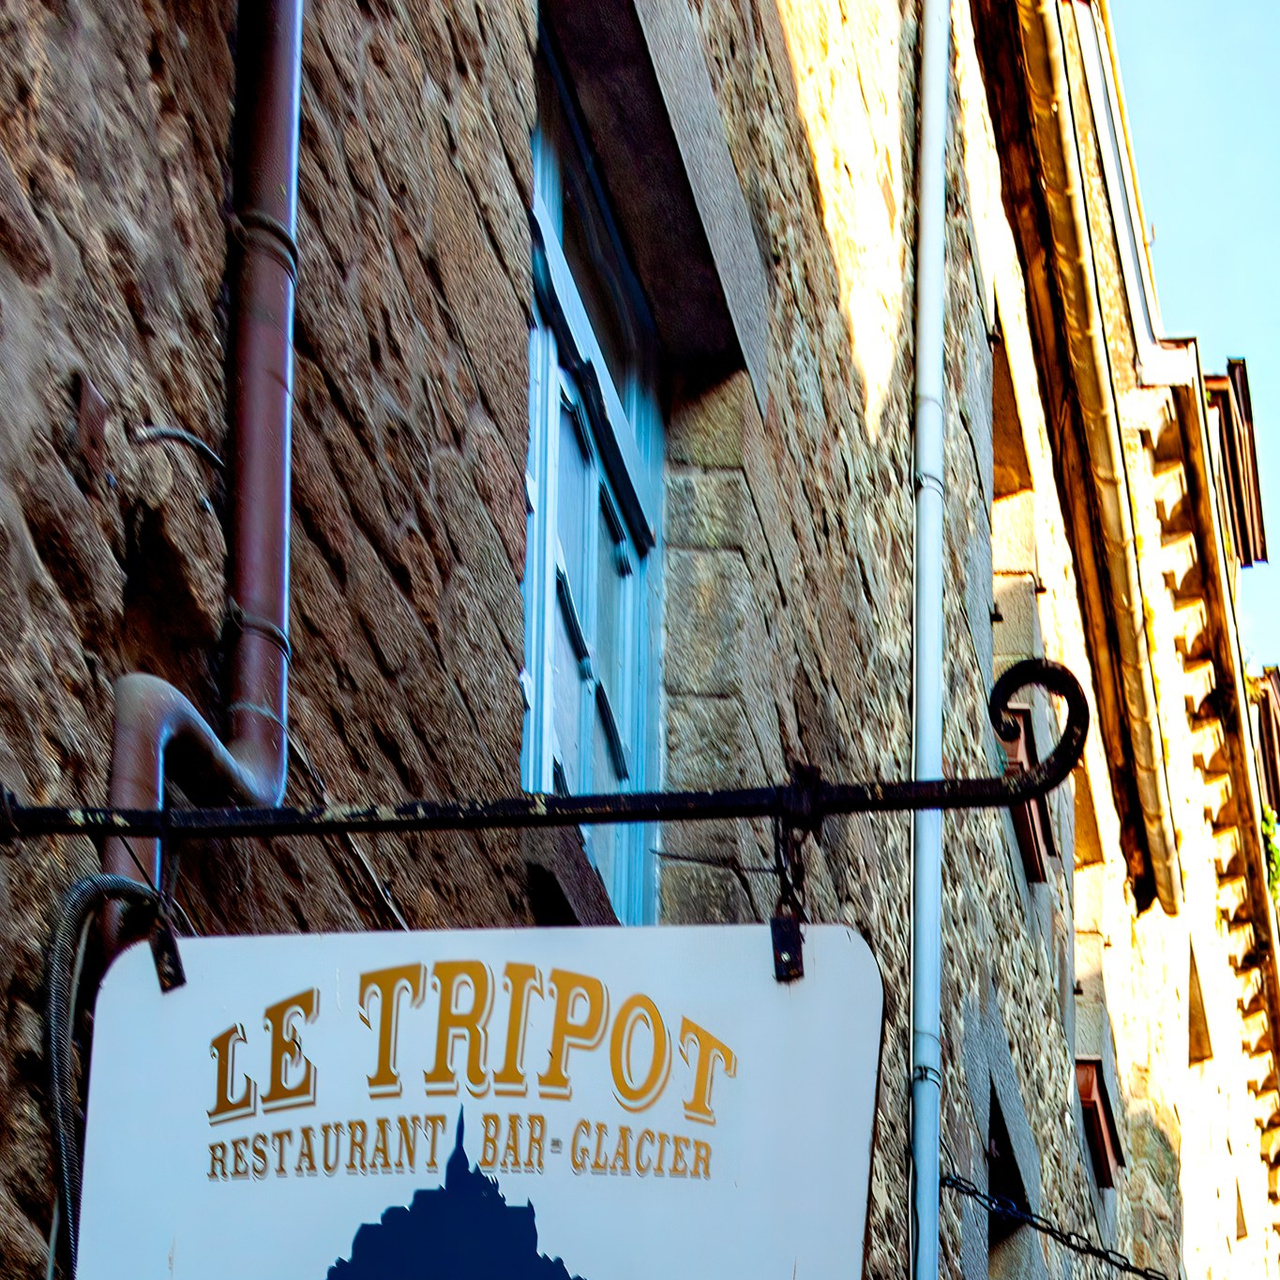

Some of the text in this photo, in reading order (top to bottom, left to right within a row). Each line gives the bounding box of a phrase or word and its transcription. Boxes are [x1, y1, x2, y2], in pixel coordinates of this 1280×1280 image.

[207, 961, 738, 1127] LE TRIPOT
[207, 1113, 447, 1182] RESTAURANT
